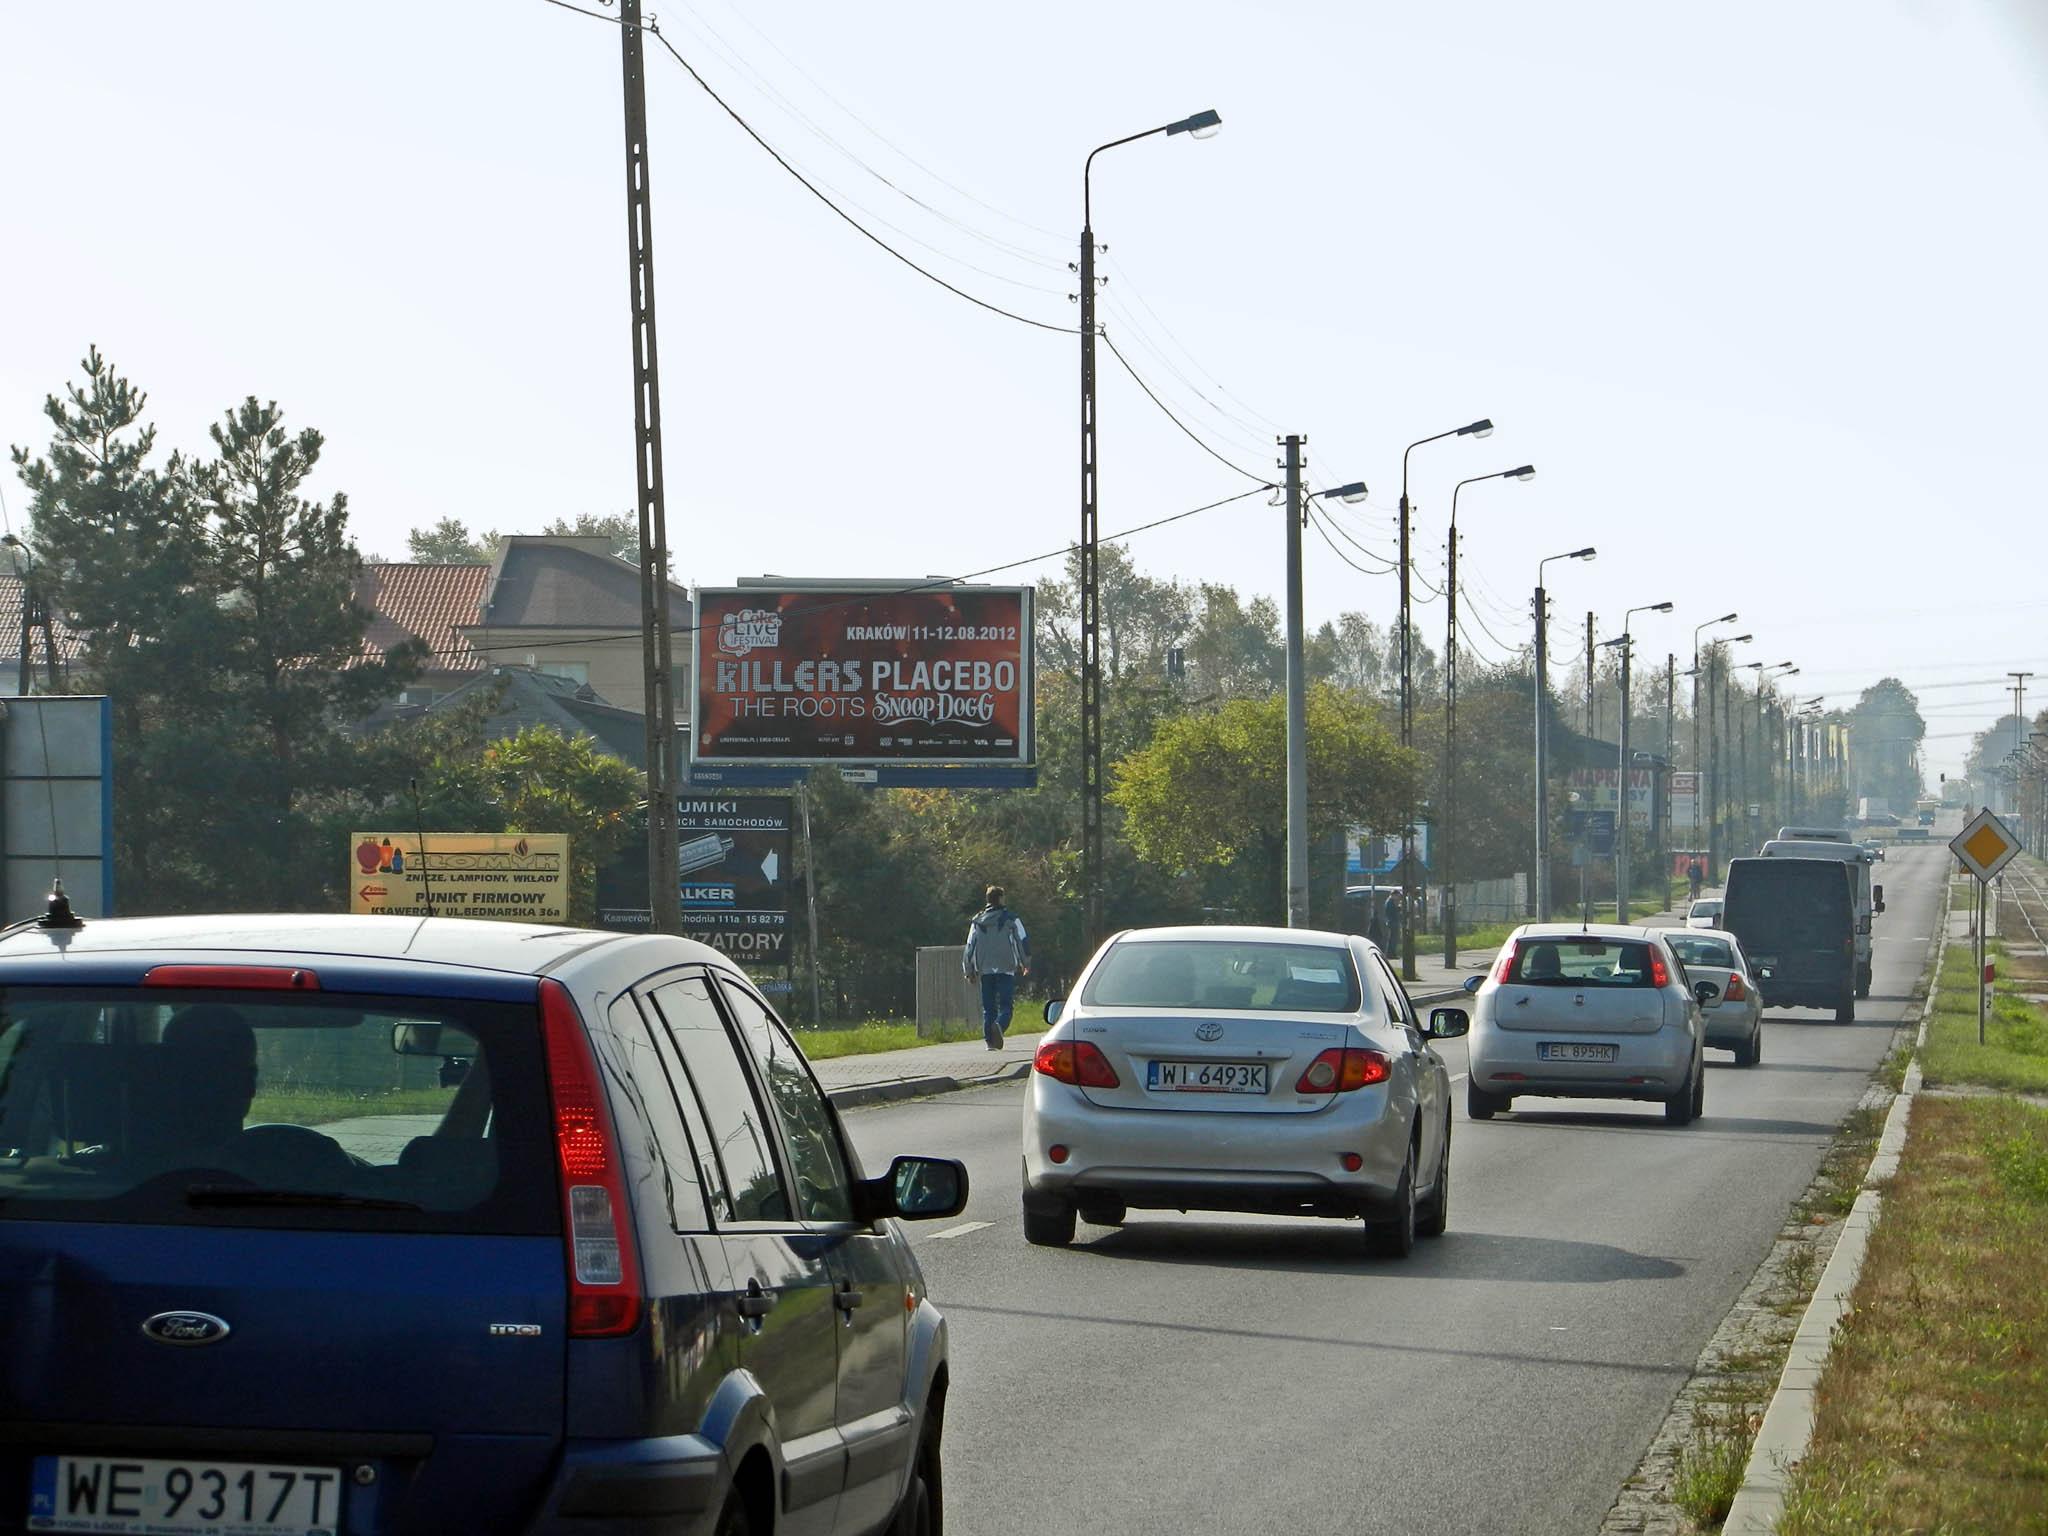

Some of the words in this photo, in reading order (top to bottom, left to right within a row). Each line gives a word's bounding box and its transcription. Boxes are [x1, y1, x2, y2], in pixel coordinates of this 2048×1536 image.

[847, 623, 906, 640] KRAKÓW
[913, 626, 1015, 640] 11-12.08.2012
[734, 636, 777, 645] FESTIVAL
[872, 661, 1015, 691] PLACEBO
[730, 697, 776, 717] THE
[783, 697, 865, 717] ROOTS
[678, 801, 737, 812] UMIKI
[704, 815, 783, 827] SAMOCHODÓW
[416, 892, 468, 904] PUNKT
[472, 892, 546, 905] FIRMOWY
[1550, 1045, 1567, 1058] EL
[1572, 1046, 1611, 1059] 895HK
[1162, 1065, 1188, 1086] WI
[1199, 1065, 1263, 1088] 6493K
[161, 1317, 207, 1338] Ford
[67, 1461, 144, 1518] WE
[164, 1467, 335, 1525] 9317T
